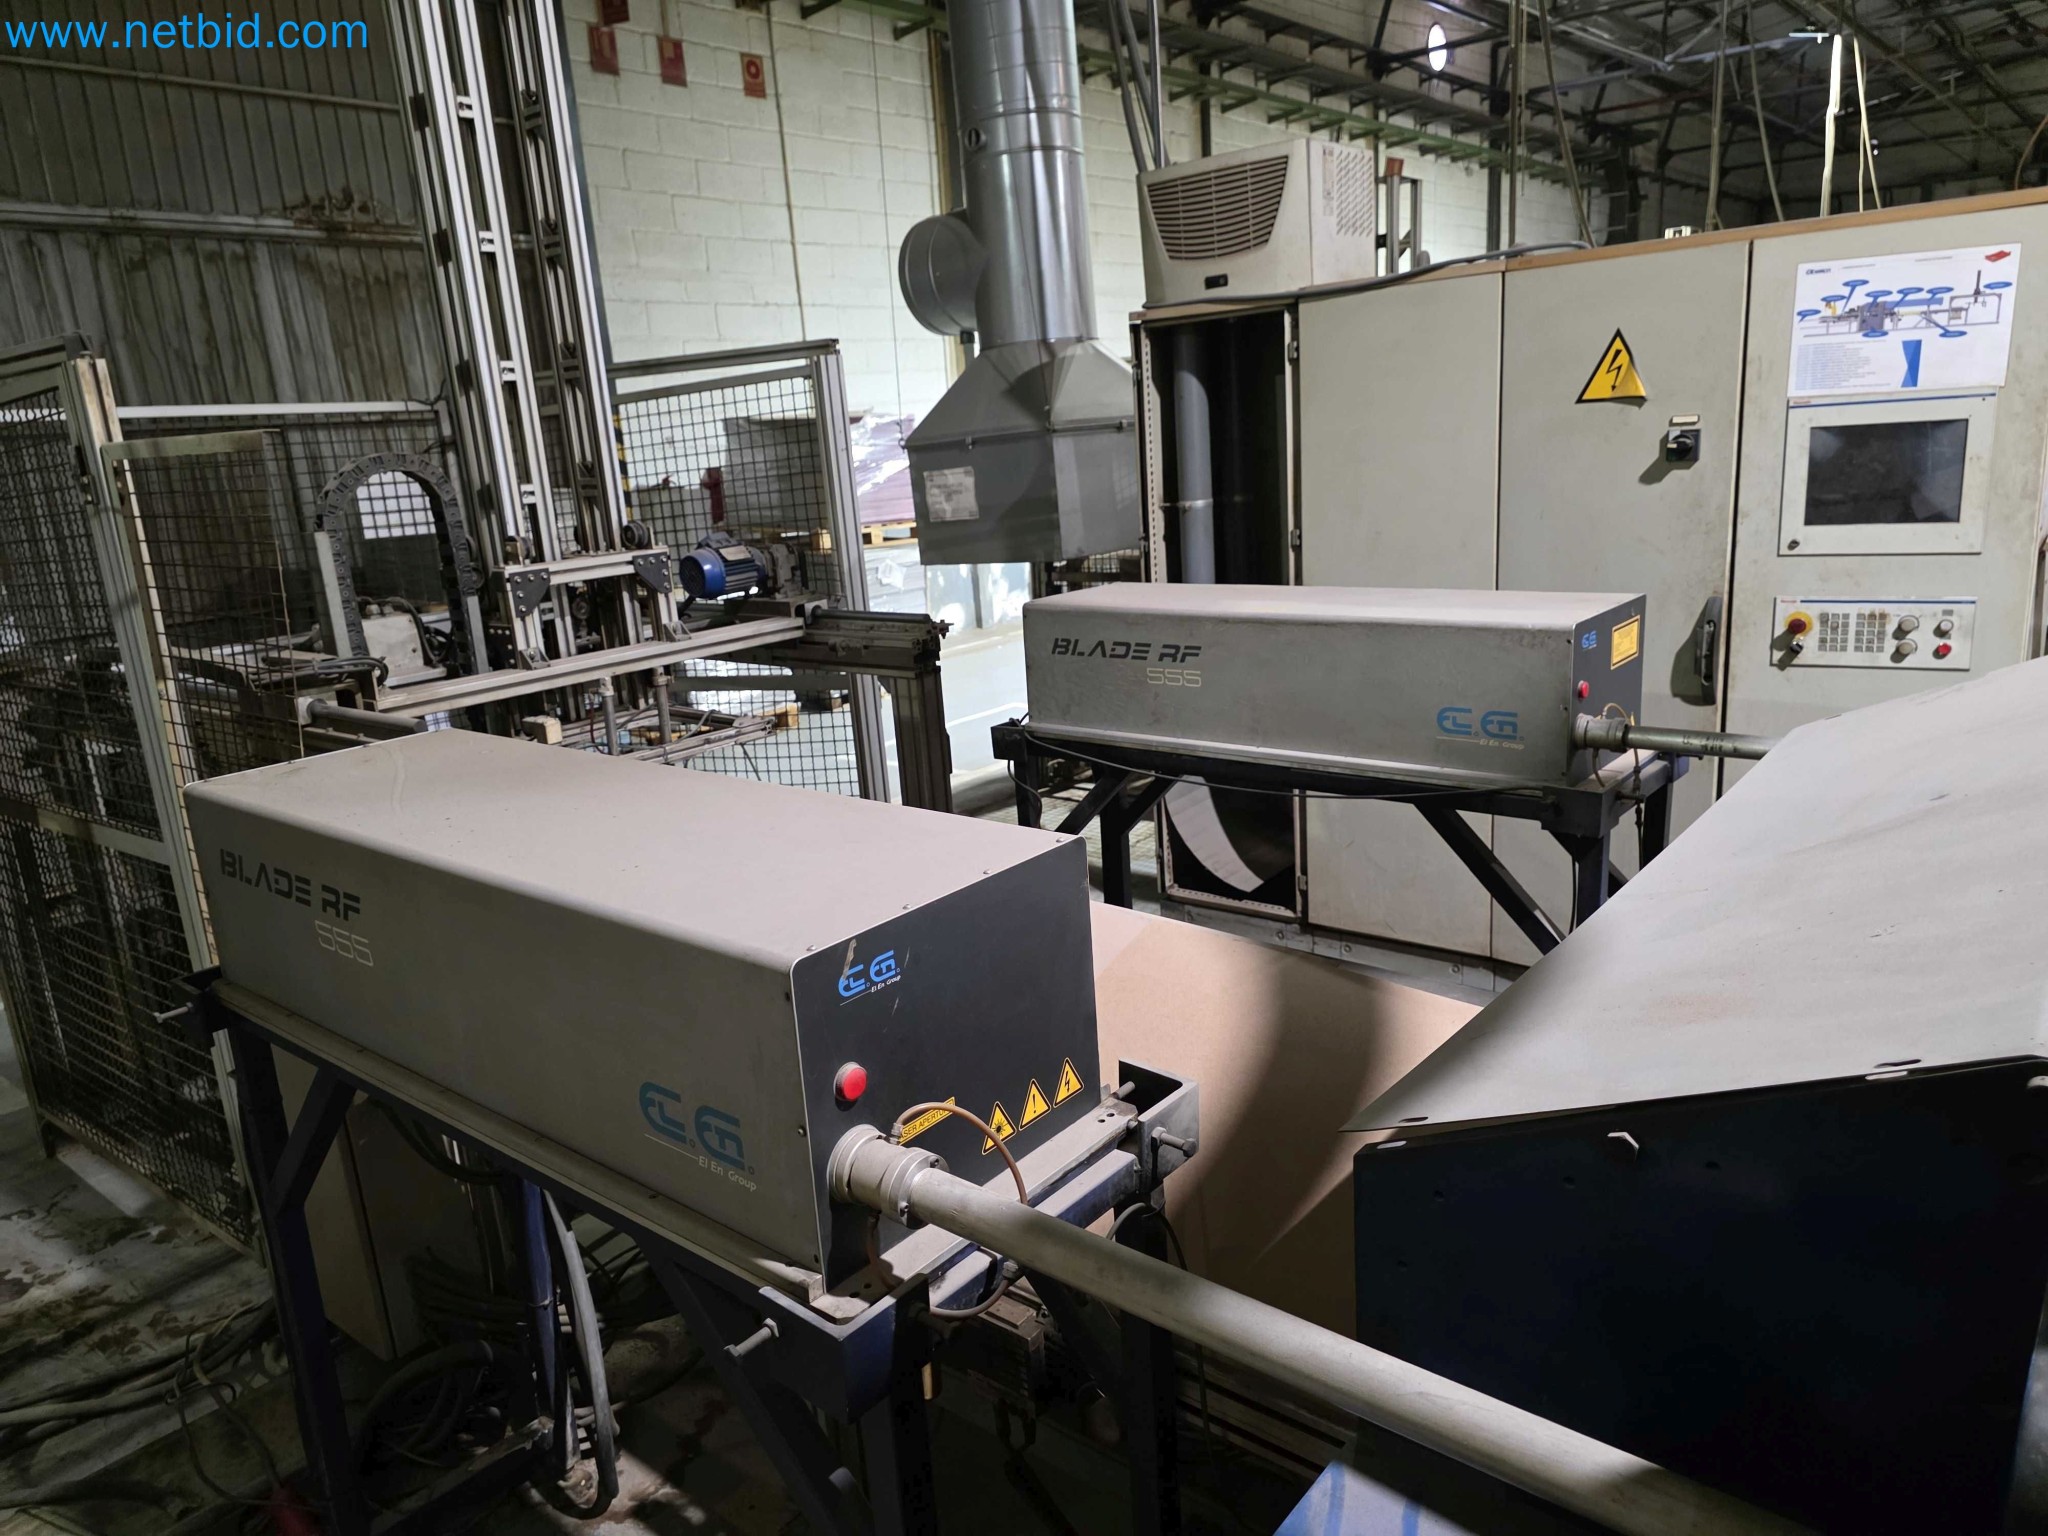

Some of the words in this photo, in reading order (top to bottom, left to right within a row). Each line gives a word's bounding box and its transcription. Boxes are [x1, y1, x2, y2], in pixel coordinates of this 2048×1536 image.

[1051, 637, 1152, 661] BLADE
[1158, 644, 1202, 664] RF
[220, 848, 312, 907] BLADE
[321, 884, 361, 921] RF
[710, 1161, 724, 1176] En
[728, 1170, 757, 1192] Group
